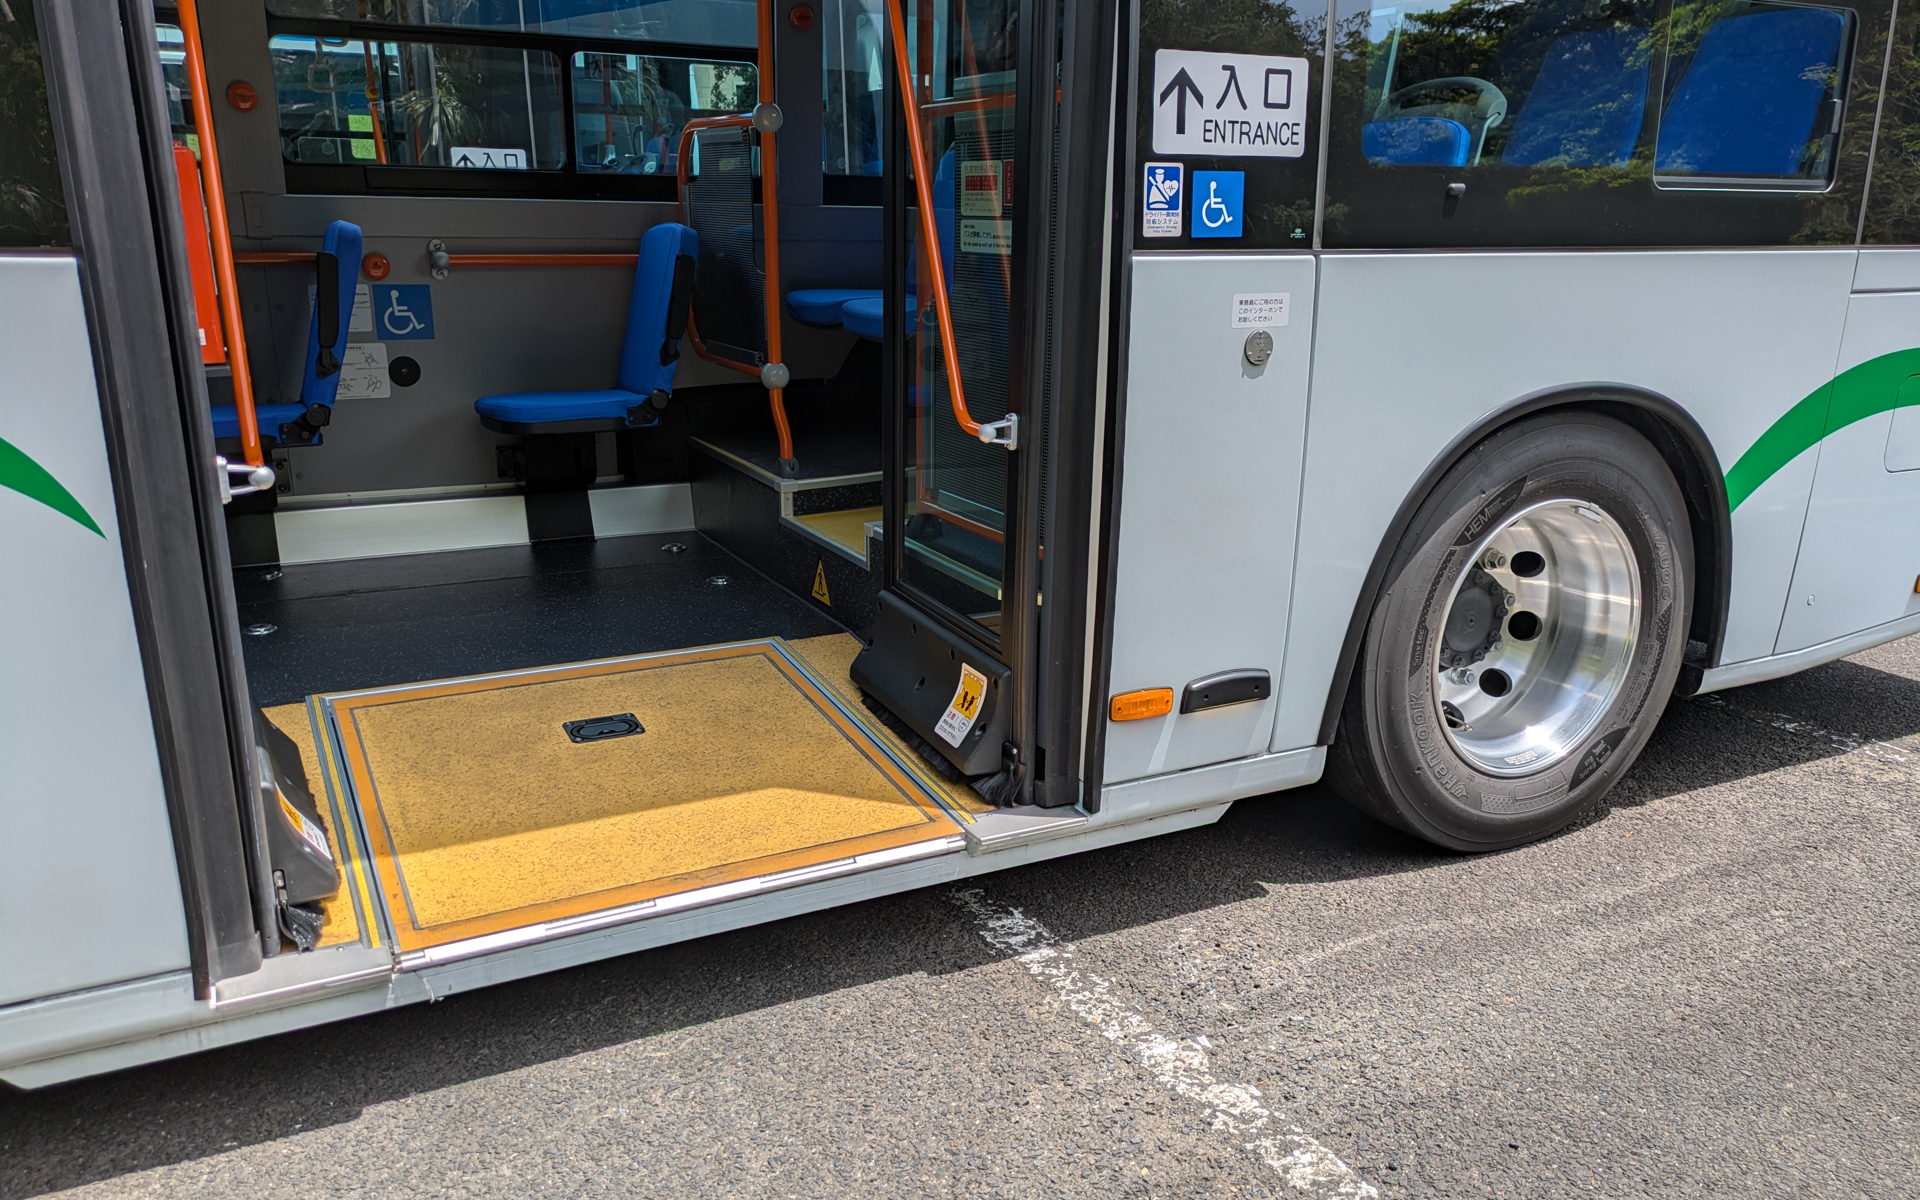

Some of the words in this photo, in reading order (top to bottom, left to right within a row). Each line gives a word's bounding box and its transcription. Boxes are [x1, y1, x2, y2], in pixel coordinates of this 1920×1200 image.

[1215, 64, 1292, 110] 入口
[1203, 119, 1300, 146] ENTRANCE
[1238, 298, 1284, 306] 乗務員にご用の方は
[1238, 307, 1283, 315] このインターホンで
[1464, 507, 1491, 540] HEM
